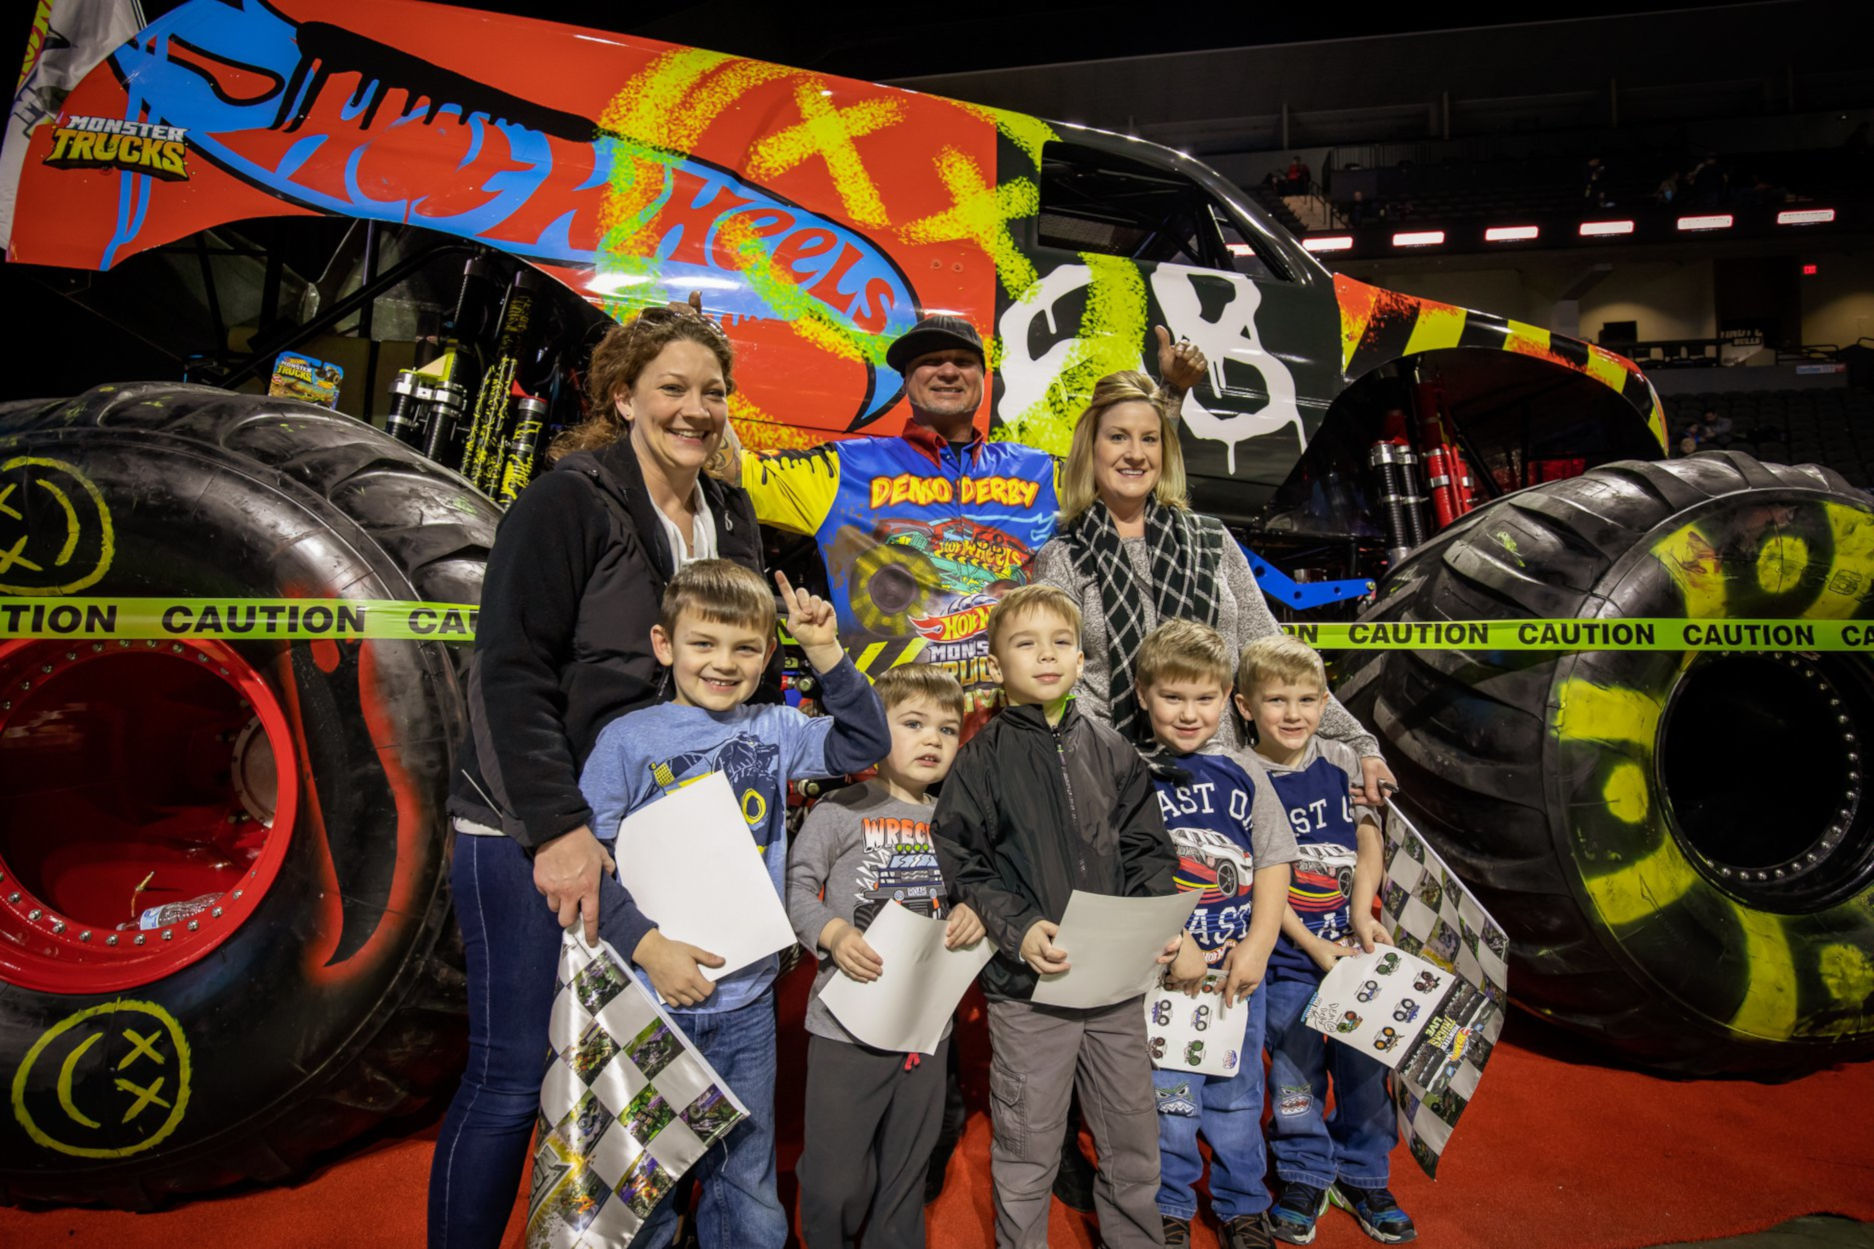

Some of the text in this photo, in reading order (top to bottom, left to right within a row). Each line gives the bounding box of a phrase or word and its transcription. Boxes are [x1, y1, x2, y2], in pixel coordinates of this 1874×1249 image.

[66, 115, 189, 142] MONSTER
[43, 127, 190, 180] TRUCKS
[870, 472, 1041, 509] DEMO DERBY
[162, 604, 365, 634] CAUTION
[1347, 623, 1488, 645] CAUTION
[1517, 622, 1654, 645] CAUTION
[1682, 624, 1815, 646] CAUTION
[1425, 1016, 1443, 1037] LIVE
[1427, 1013, 1457, 1049] TRUCKS
